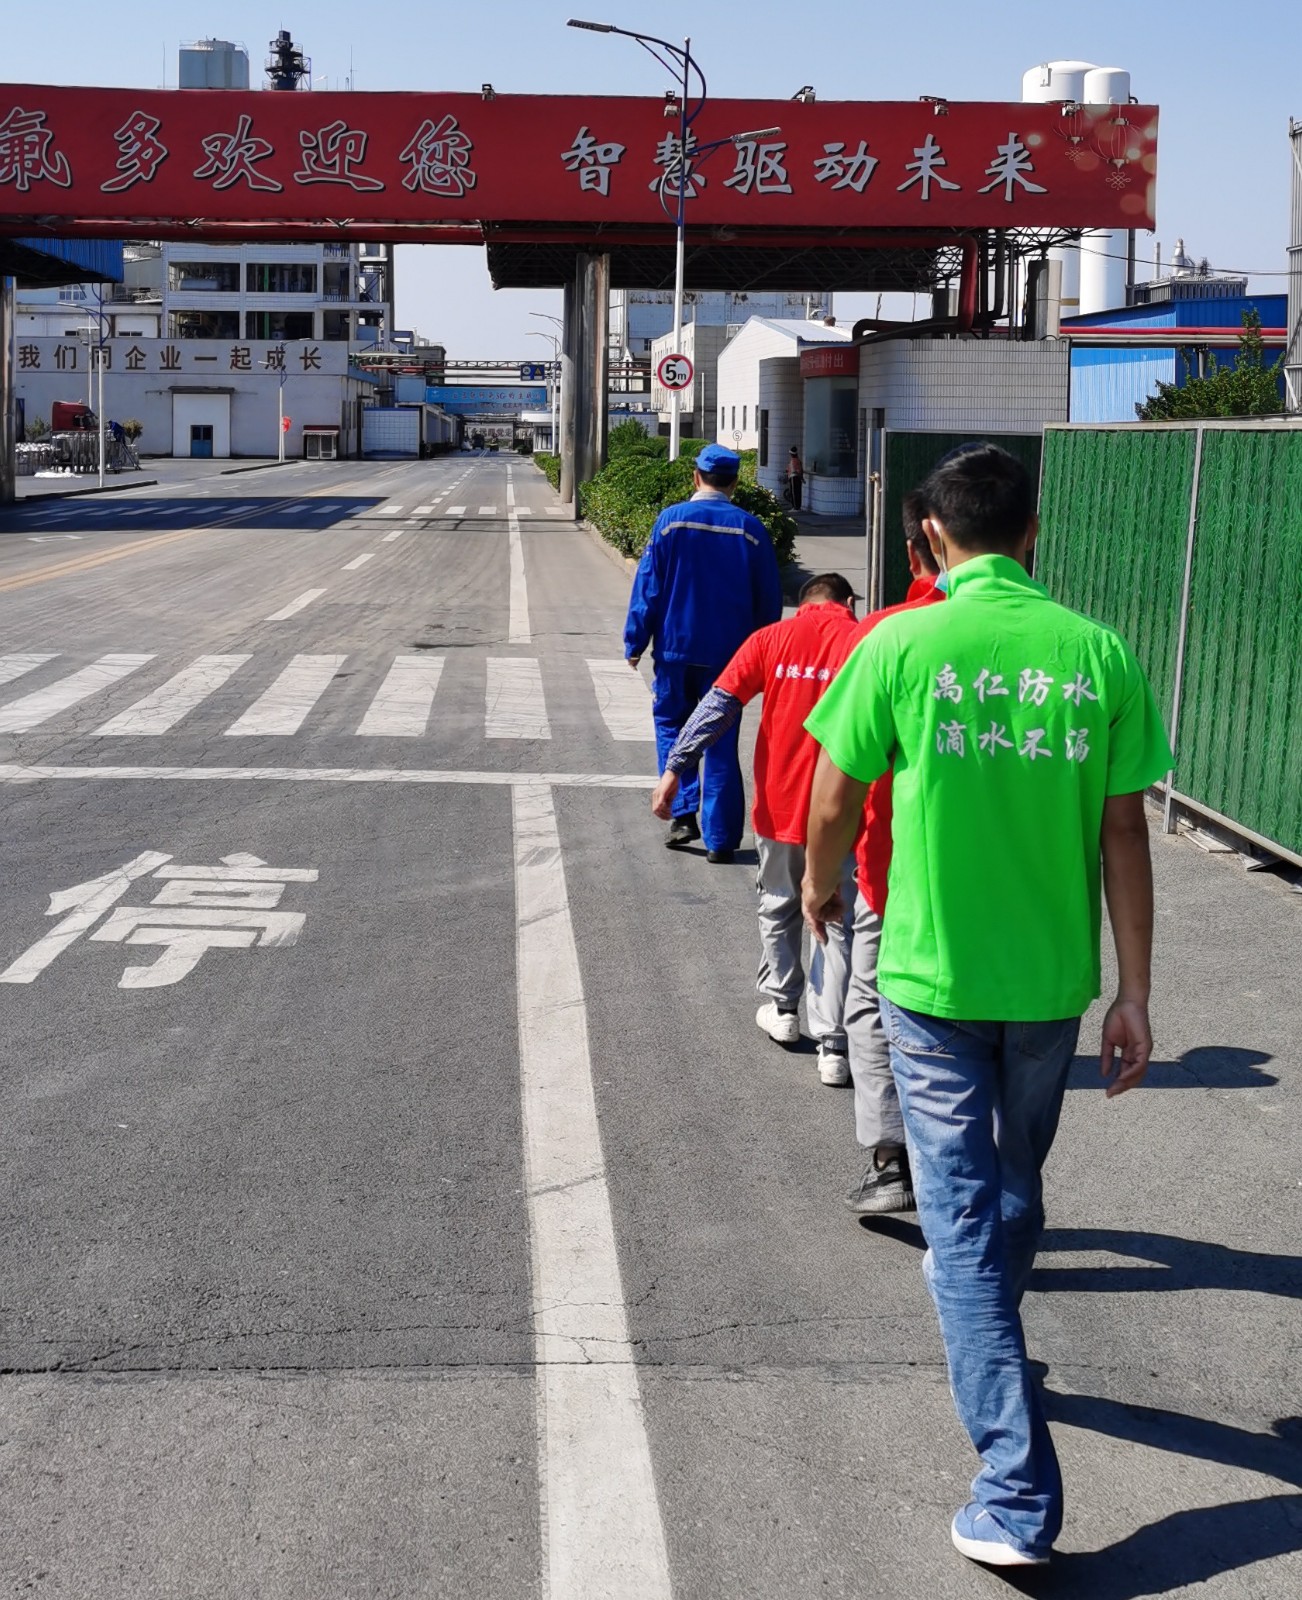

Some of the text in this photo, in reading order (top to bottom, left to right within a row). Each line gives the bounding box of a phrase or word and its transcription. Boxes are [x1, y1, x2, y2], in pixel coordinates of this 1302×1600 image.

[559, 124, 1048, 202] 智慧驱动未来
[18, 344, 322, 371] 我们同企业一起成长
[665, 363, 687, 381] 5m
[936, 720, 1091, 763] 滴水不漏
[0, 849, 320, 989] 停
